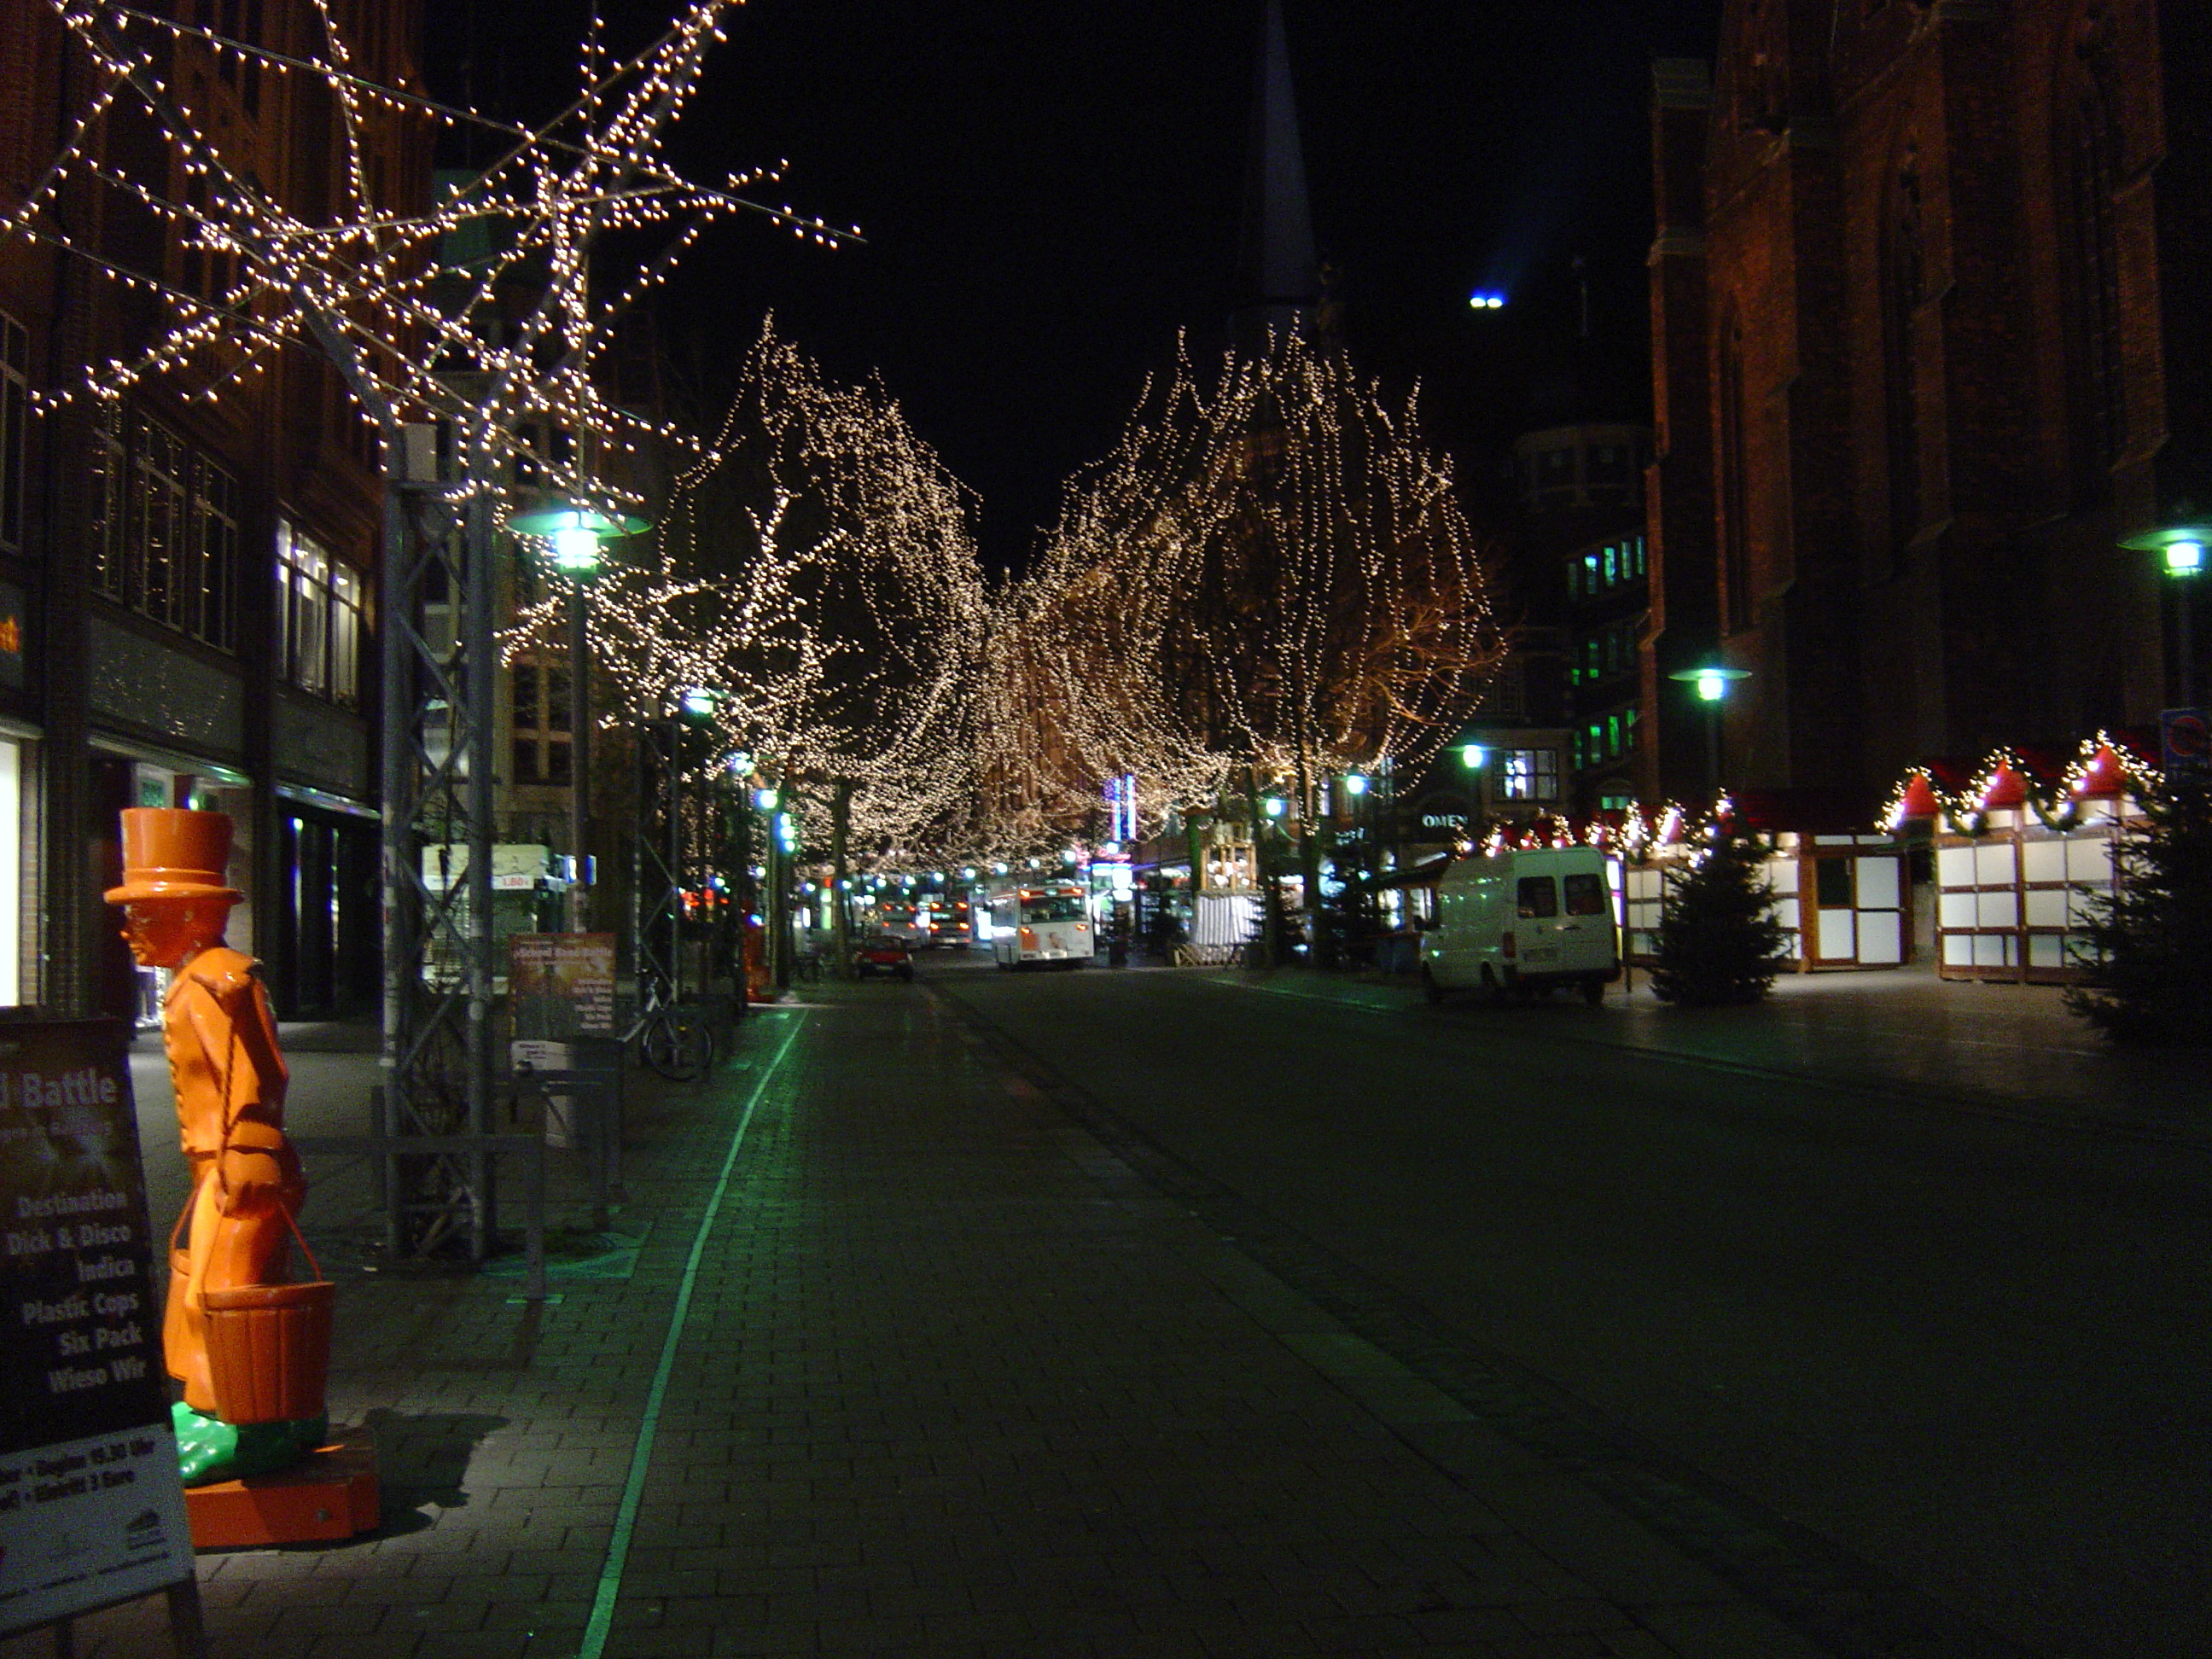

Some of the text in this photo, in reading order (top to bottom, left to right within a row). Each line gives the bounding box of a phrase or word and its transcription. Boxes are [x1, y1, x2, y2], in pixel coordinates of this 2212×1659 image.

[23, 1068, 118, 1108] Battle
[17, 1188, 127, 1217] Destination
[7, 1222, 131, 1255] Dick & Disco
[76, 1255, 134, 1281] Indica
[22, 1295, 90, 1324] Plastic
[58, 1321, 143, 1356] Six Pack
[112, 1356, 147, 1382] Wir
[102, 1470, 135, 1488] Euro
